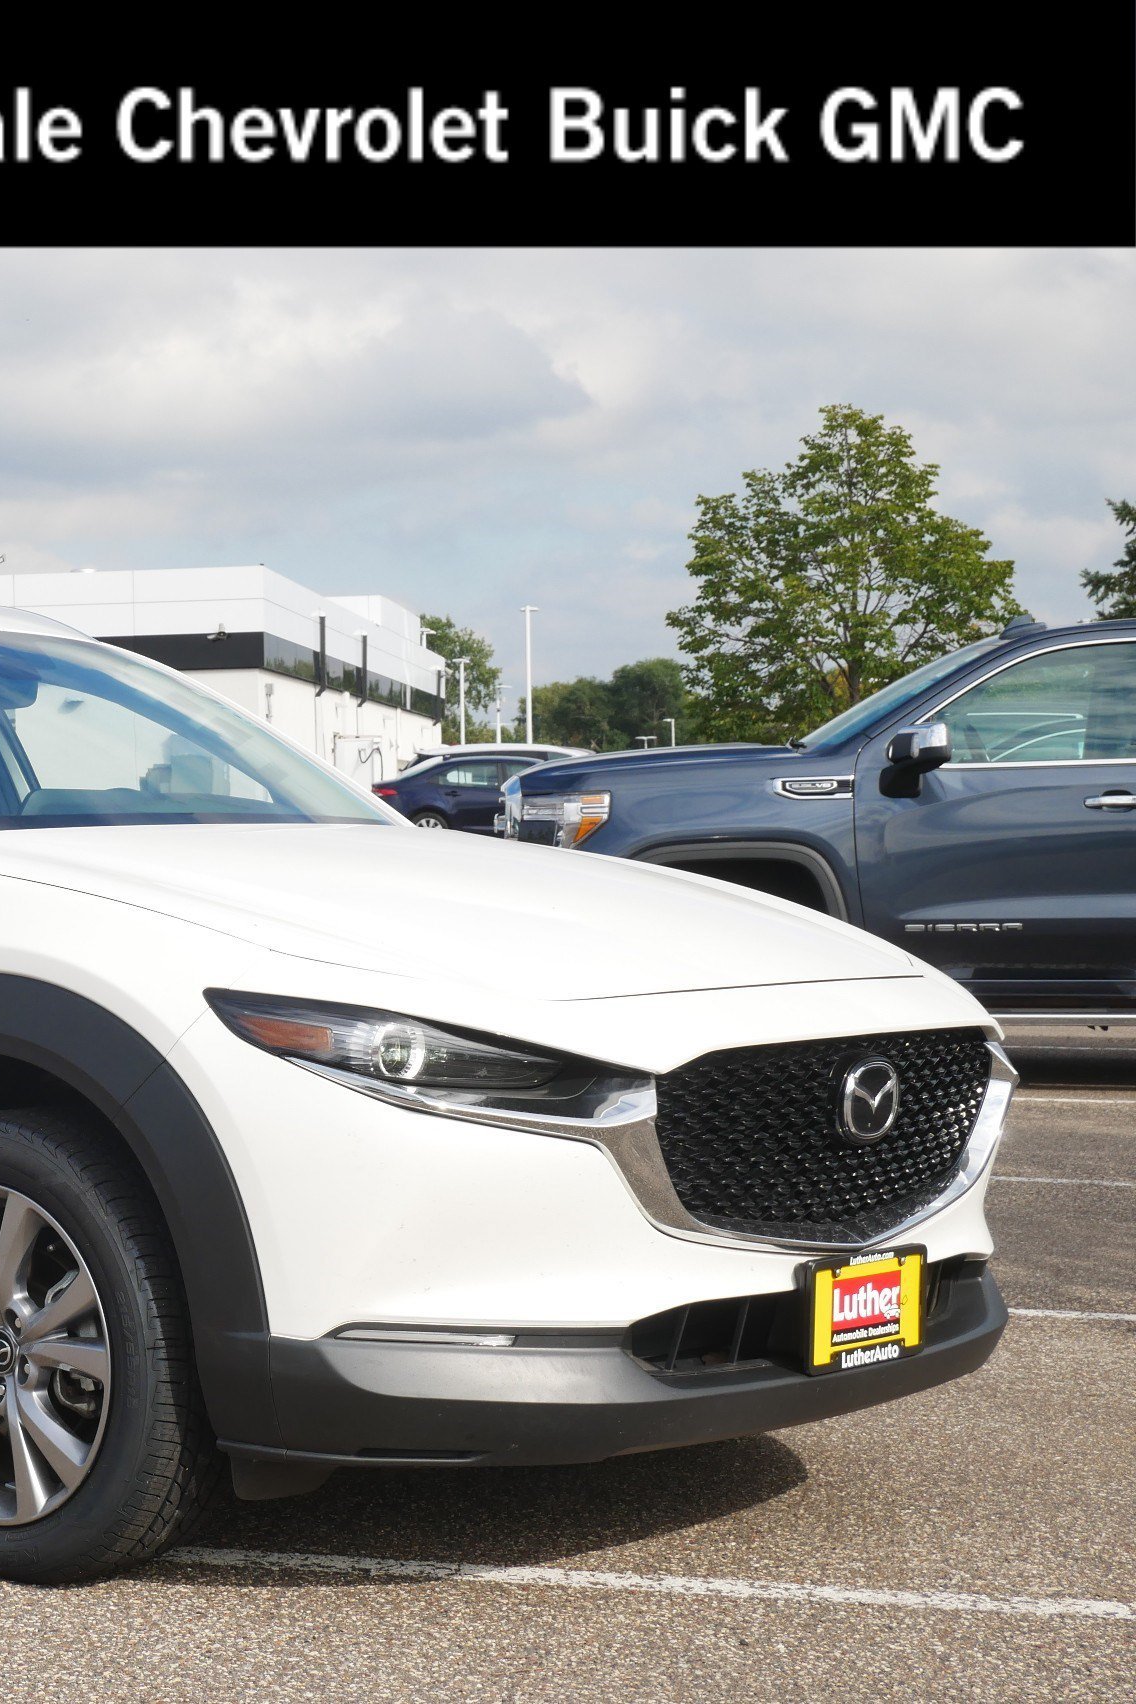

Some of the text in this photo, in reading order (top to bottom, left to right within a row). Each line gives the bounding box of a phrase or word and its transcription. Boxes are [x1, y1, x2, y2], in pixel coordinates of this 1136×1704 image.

[904, 922, 1024, 933] SIERRA
[849, 1251, 895, 1266] LutherAuto.com
[832, 1282, 901, 1322] Luther
[832, 1322, 899, 1343] Automobile Dealerships
[841, 1343, 900, 1369] LutherAuto
